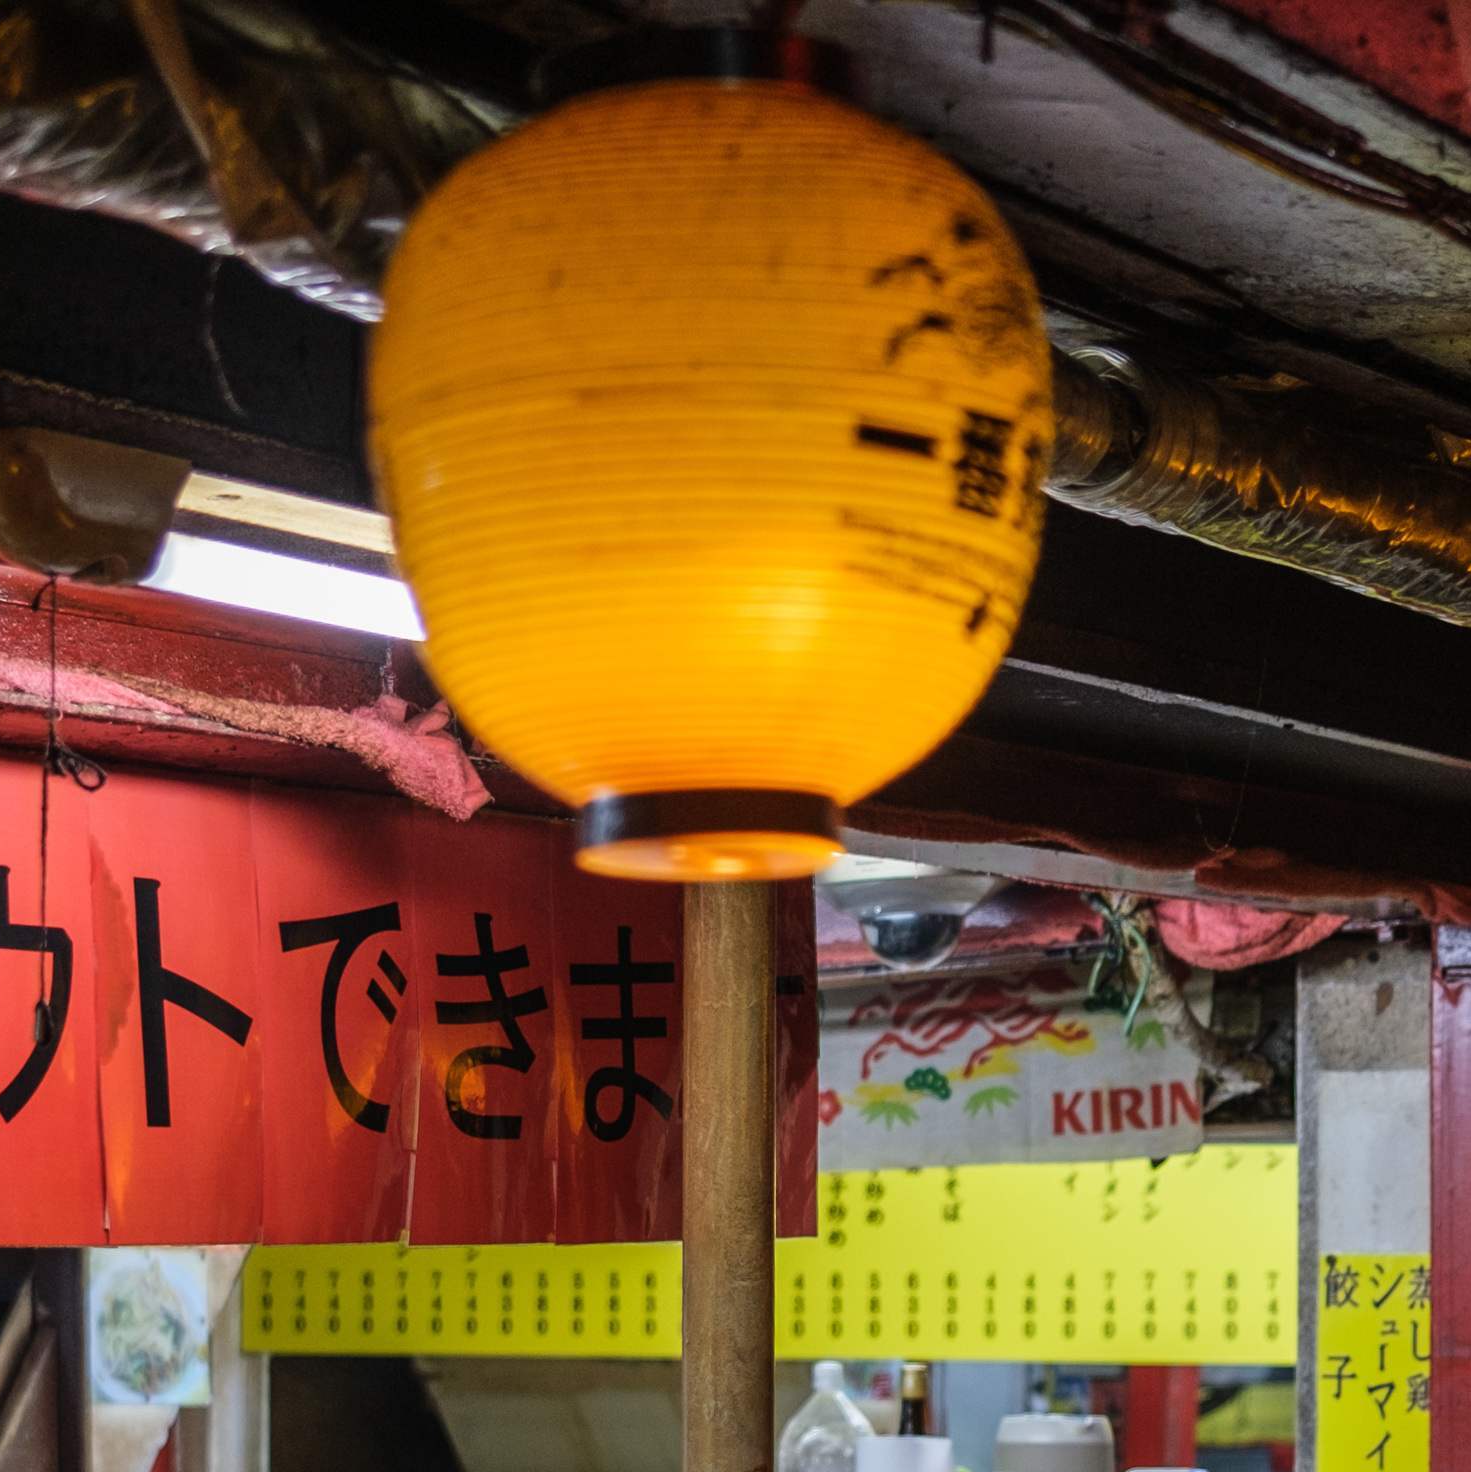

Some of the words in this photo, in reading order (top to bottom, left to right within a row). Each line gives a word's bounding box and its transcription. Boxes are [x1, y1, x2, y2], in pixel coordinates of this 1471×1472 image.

[1052, 1078, 1201, 1136] KIRIN
[1324, 1262, 1360, 1400] 餃子
[1366, 1263, 1404, 1471] シューマイ
